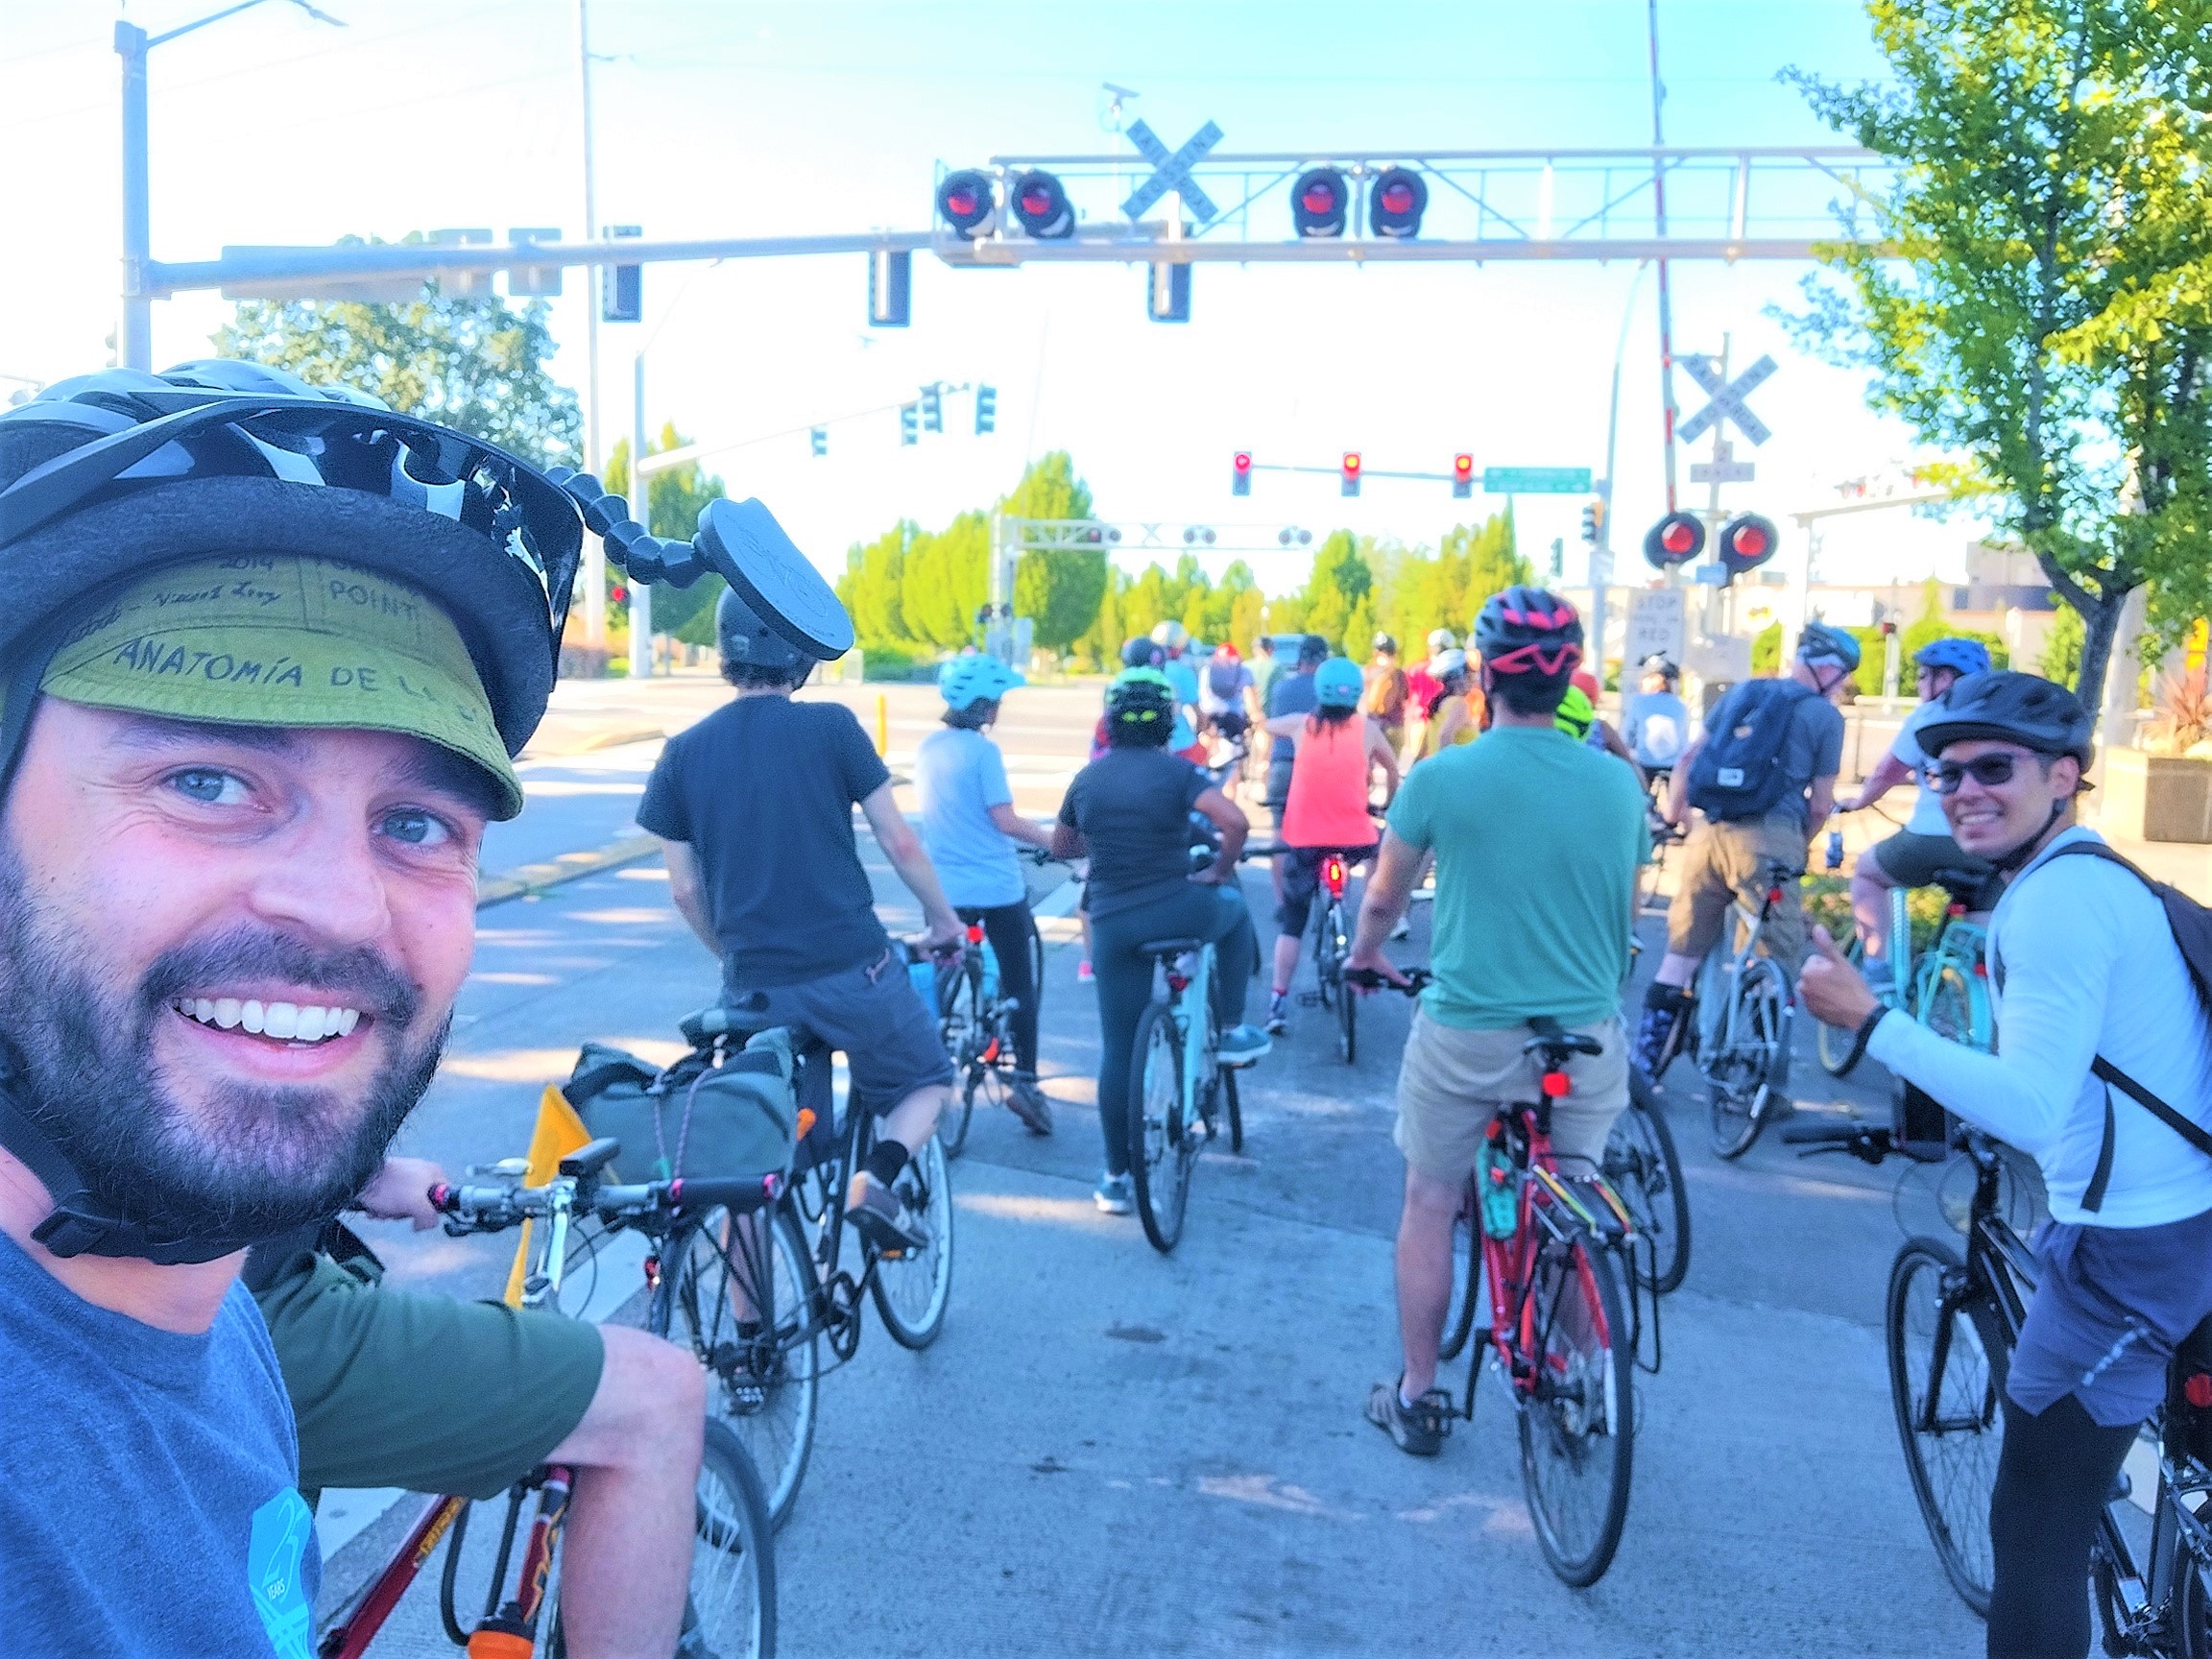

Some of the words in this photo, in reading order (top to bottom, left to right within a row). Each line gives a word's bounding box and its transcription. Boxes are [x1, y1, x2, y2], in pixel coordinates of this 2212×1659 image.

[328, 579, 419, 621] POINT
[1637, 595, 1678, 610] STOP
[112, 637, 304, 688] ANATOMÍA
[329, 666, 380, 692] DE
